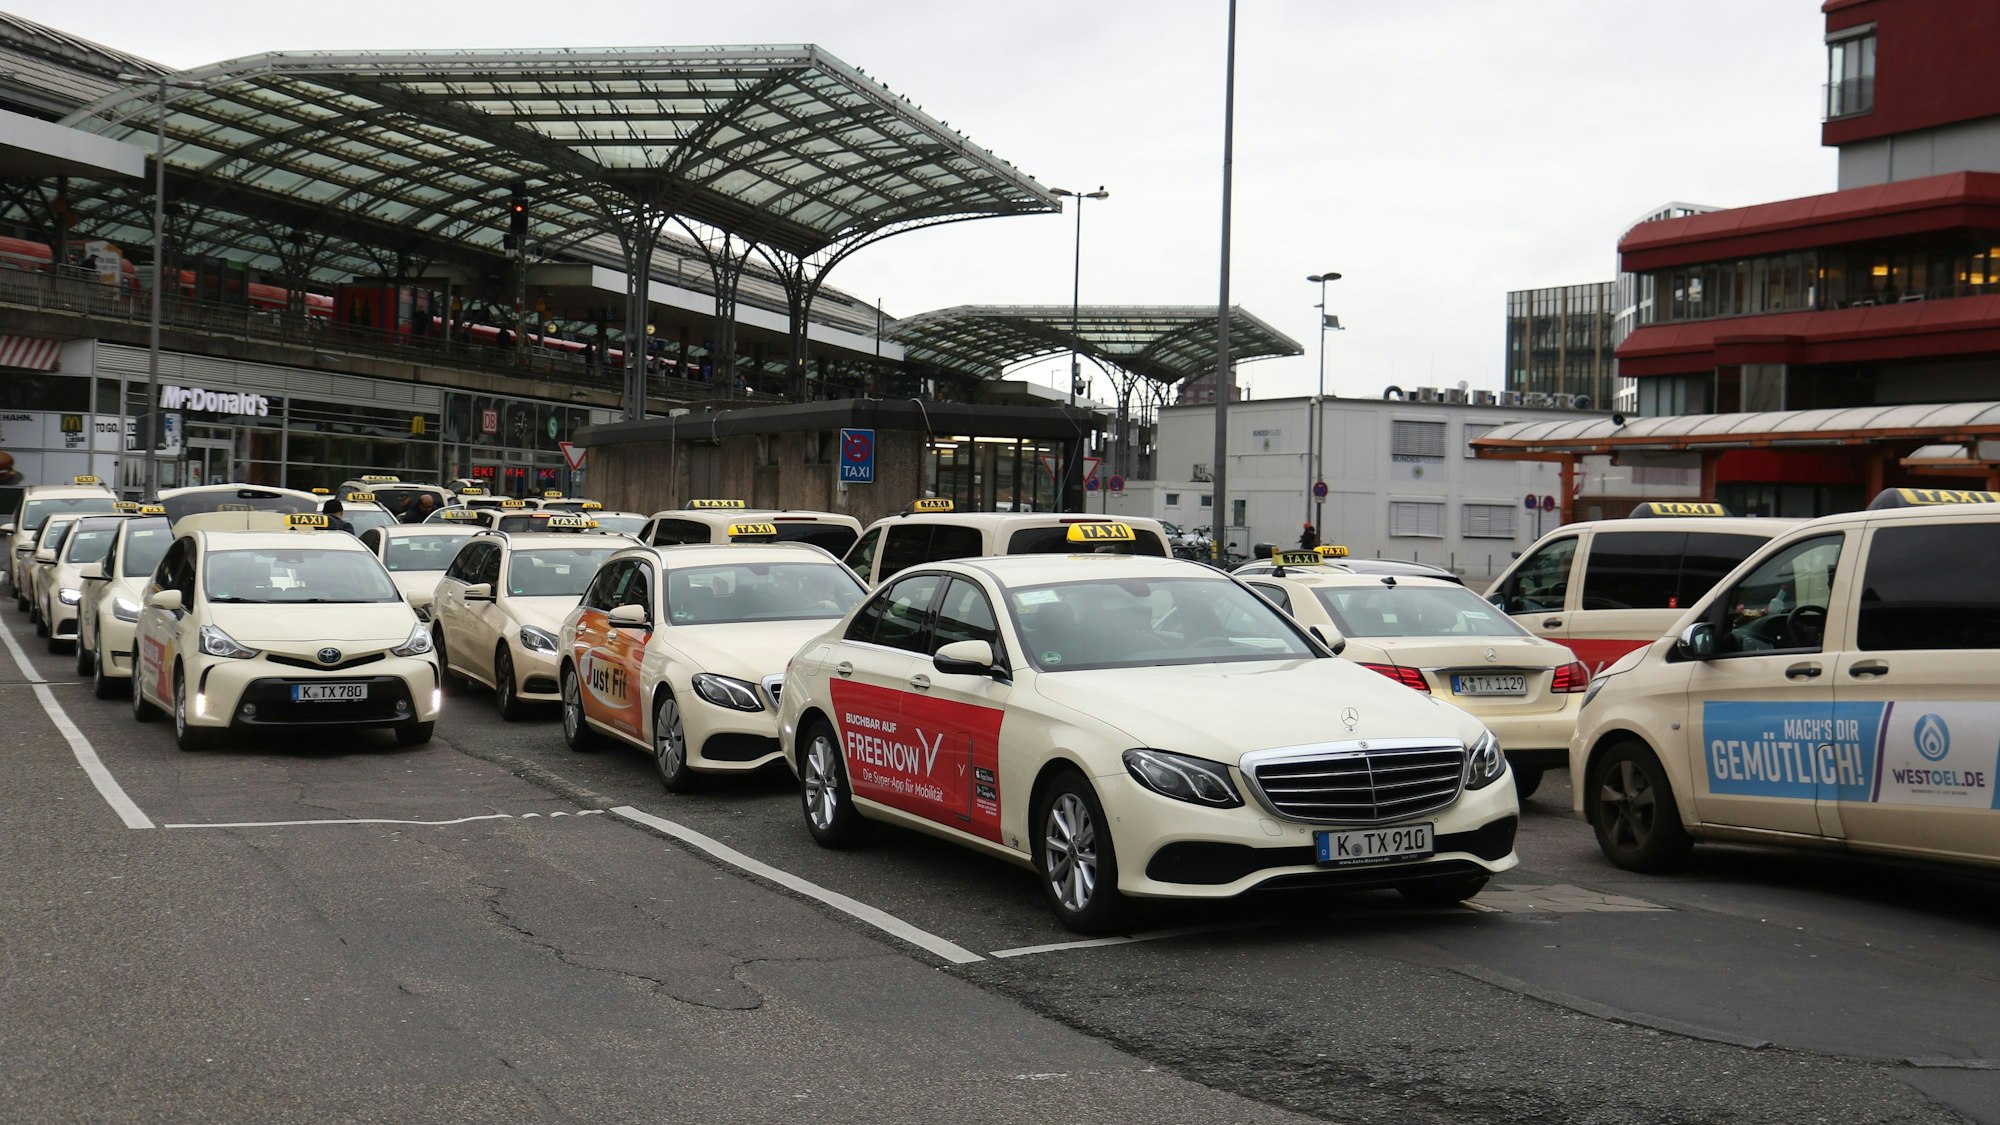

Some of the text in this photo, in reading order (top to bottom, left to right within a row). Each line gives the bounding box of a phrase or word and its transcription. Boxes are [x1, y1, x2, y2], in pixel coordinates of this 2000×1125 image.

[159, 385, 269, 417] McDonald's
[95, 423, 104, 432] TO
[484, 414, 496, 428] DB
[843, 465, 870, 478] TAXI
[1917, 490, 1988, 503] TAXI
[922, 500, 949, 508] TAXI
[1663, 503, 1709, 513] TAXI
[293, 515, 322, 525] TAXI
[554, 517, 582, 526] TAXI
[738, 525, 770, 533] TAXI
[1083, 525, 1126, 538] TAXI
[1287, 554, 1315, 563] TAXI
[612, 667, 627, 700] Fit
[1460, 677, 1469, 691] K
[1476, 677, 1493, 690] TX
[1496, 676, 1524, 691] 1129
[303, 685, 362, 699] K TX 780
[846, 712, 897, 733] BUCHBAR AUF
[1784, 719, 1860, 741] MACH'S DIR
[847, 730, 919, 776] FREENOW
[1711, 732, 1865, 786] GEMÜTLICH!
[863, 768, 943, 802] Die Super-App für Mobilität
[1892, 768, 1985, 788] WESTOEL.DE
[1337, 828, 1425, 856] K TX 910
